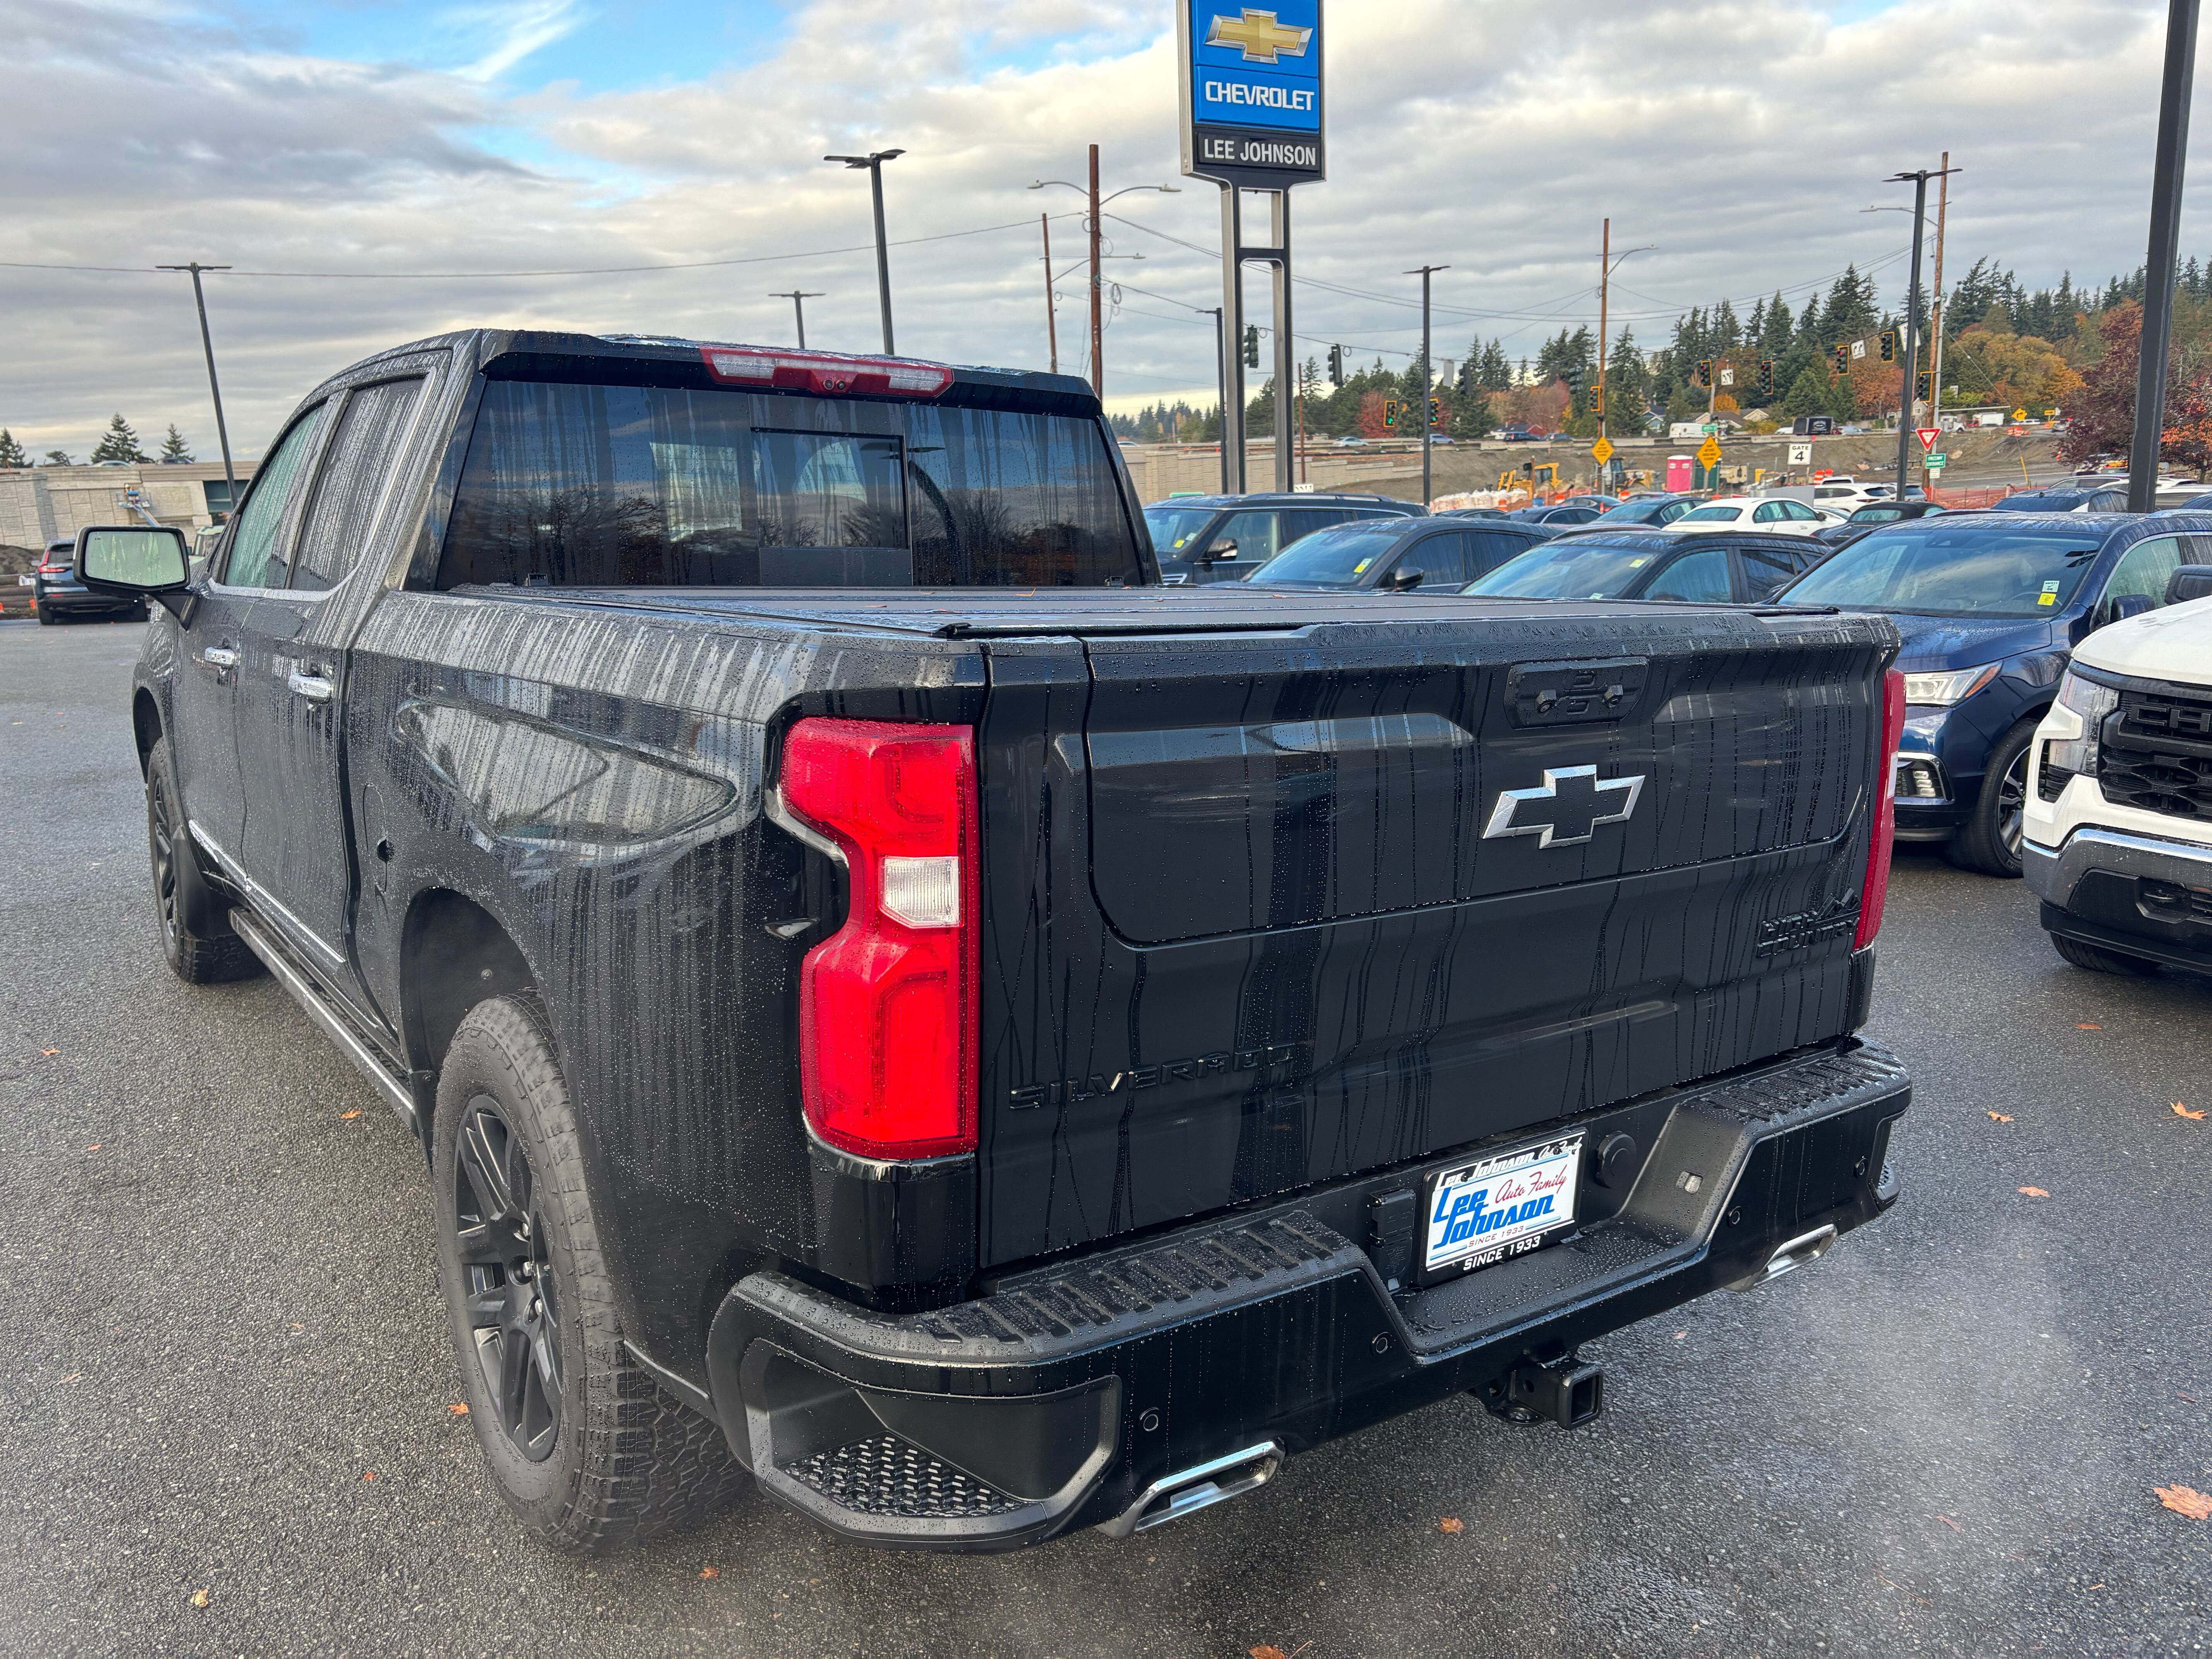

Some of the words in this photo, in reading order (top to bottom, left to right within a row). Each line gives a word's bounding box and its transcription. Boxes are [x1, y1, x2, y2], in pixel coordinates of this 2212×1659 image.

[1205, 81, 1314, 111] CHEVROLET
[1204, 139, 1235, 159] LEE
[1240, 142, 1316, 165] JOHNSON
[1795, 451, 1804, 461] 4
[1009, 1042, 1297, 1110] SILVERADO
[1468, 1152, 1535, 1180] Johnson
[1495, 1179, 1526, 1204] Auto
[1527, 1164, 1568, 1195] Family
[1433, 1186, 1489, 1223] Lee
[1432, 1194, 1555, 1250] Johnson
[1468, 1233, 1497, 1247] SINCE
[1501, 1226, 1524, 1238] 1933
[1463, 1247, 1504, 1271] SINCE
[1510, 1235, 1541, 1255] 1933
